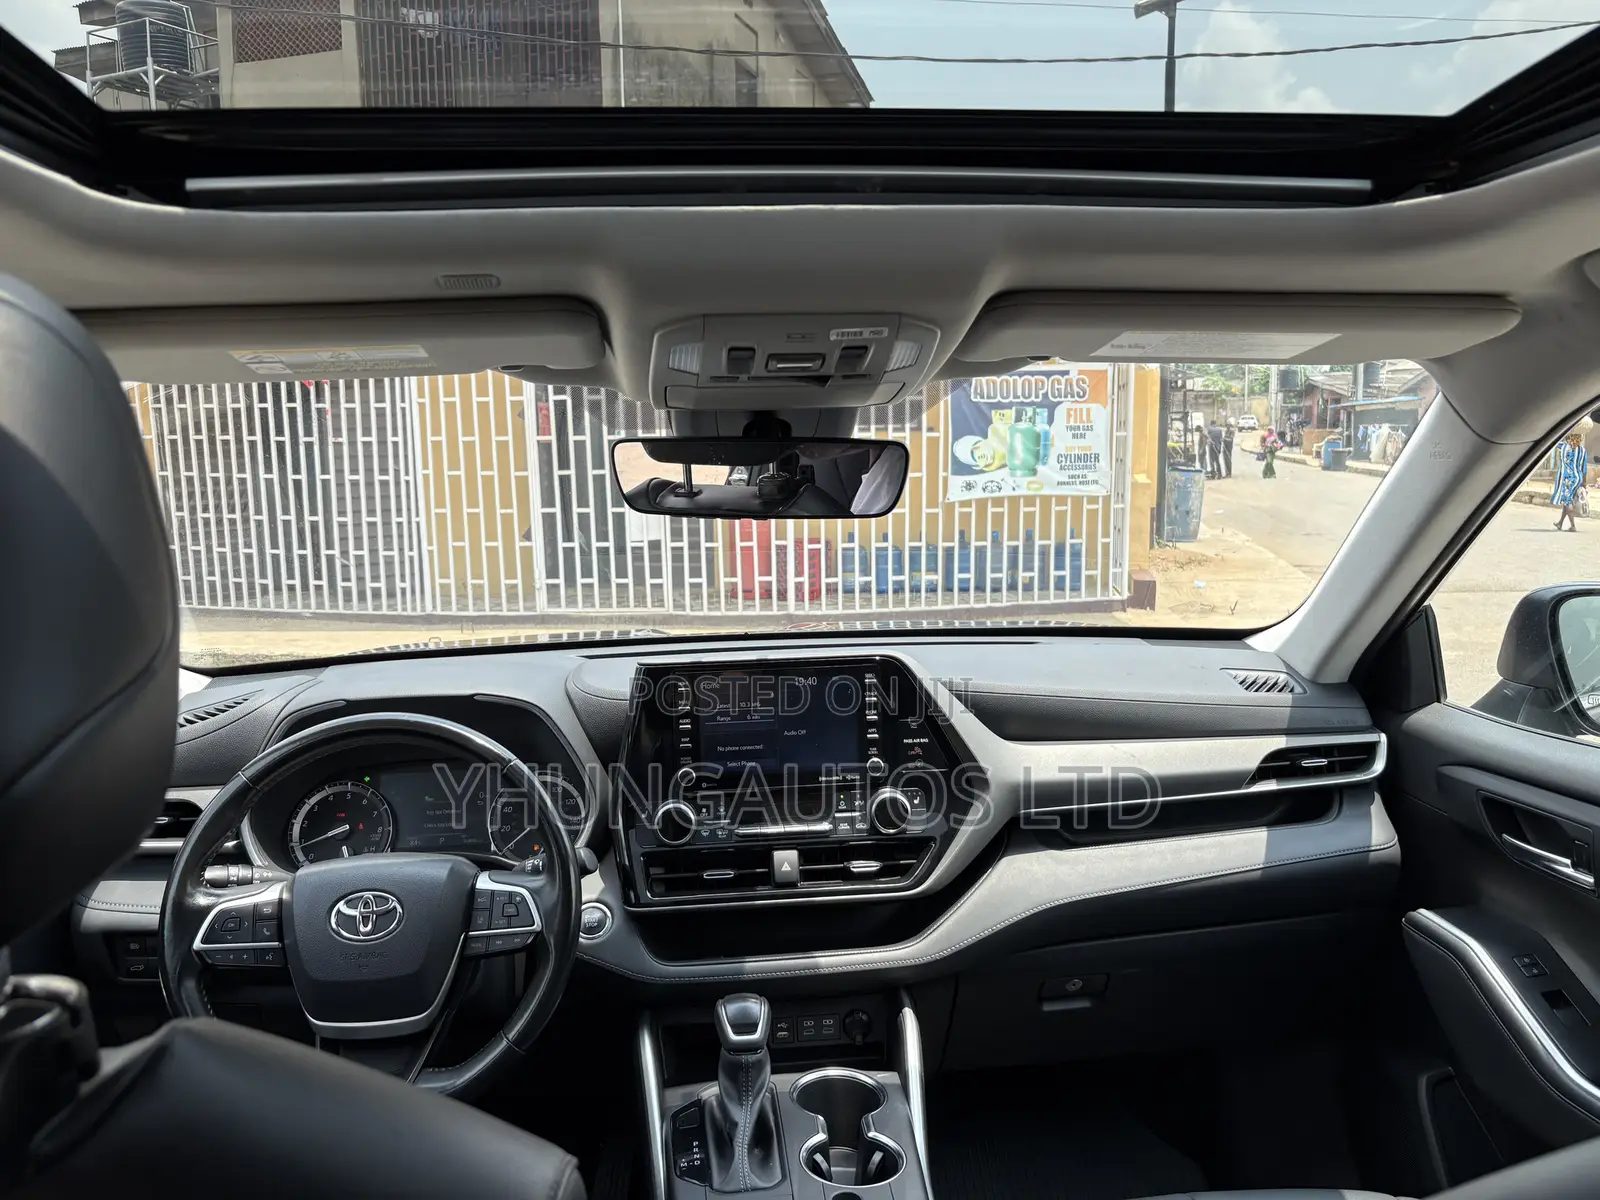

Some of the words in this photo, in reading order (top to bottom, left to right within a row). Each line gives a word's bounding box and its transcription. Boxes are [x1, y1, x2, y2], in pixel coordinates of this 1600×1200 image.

[972, 376, 1047, 402] ADOLOP
[1048, 375, 1090, 402] GAS
[1066, 407, 1092, 424] FILL
[1082, 424, 1094, 432] GAS
[1071, 432, 1087, 440] HERE
[1056, 452, 1100, 464] CYLINDER
[795, 676, 817, 686] 19:40
